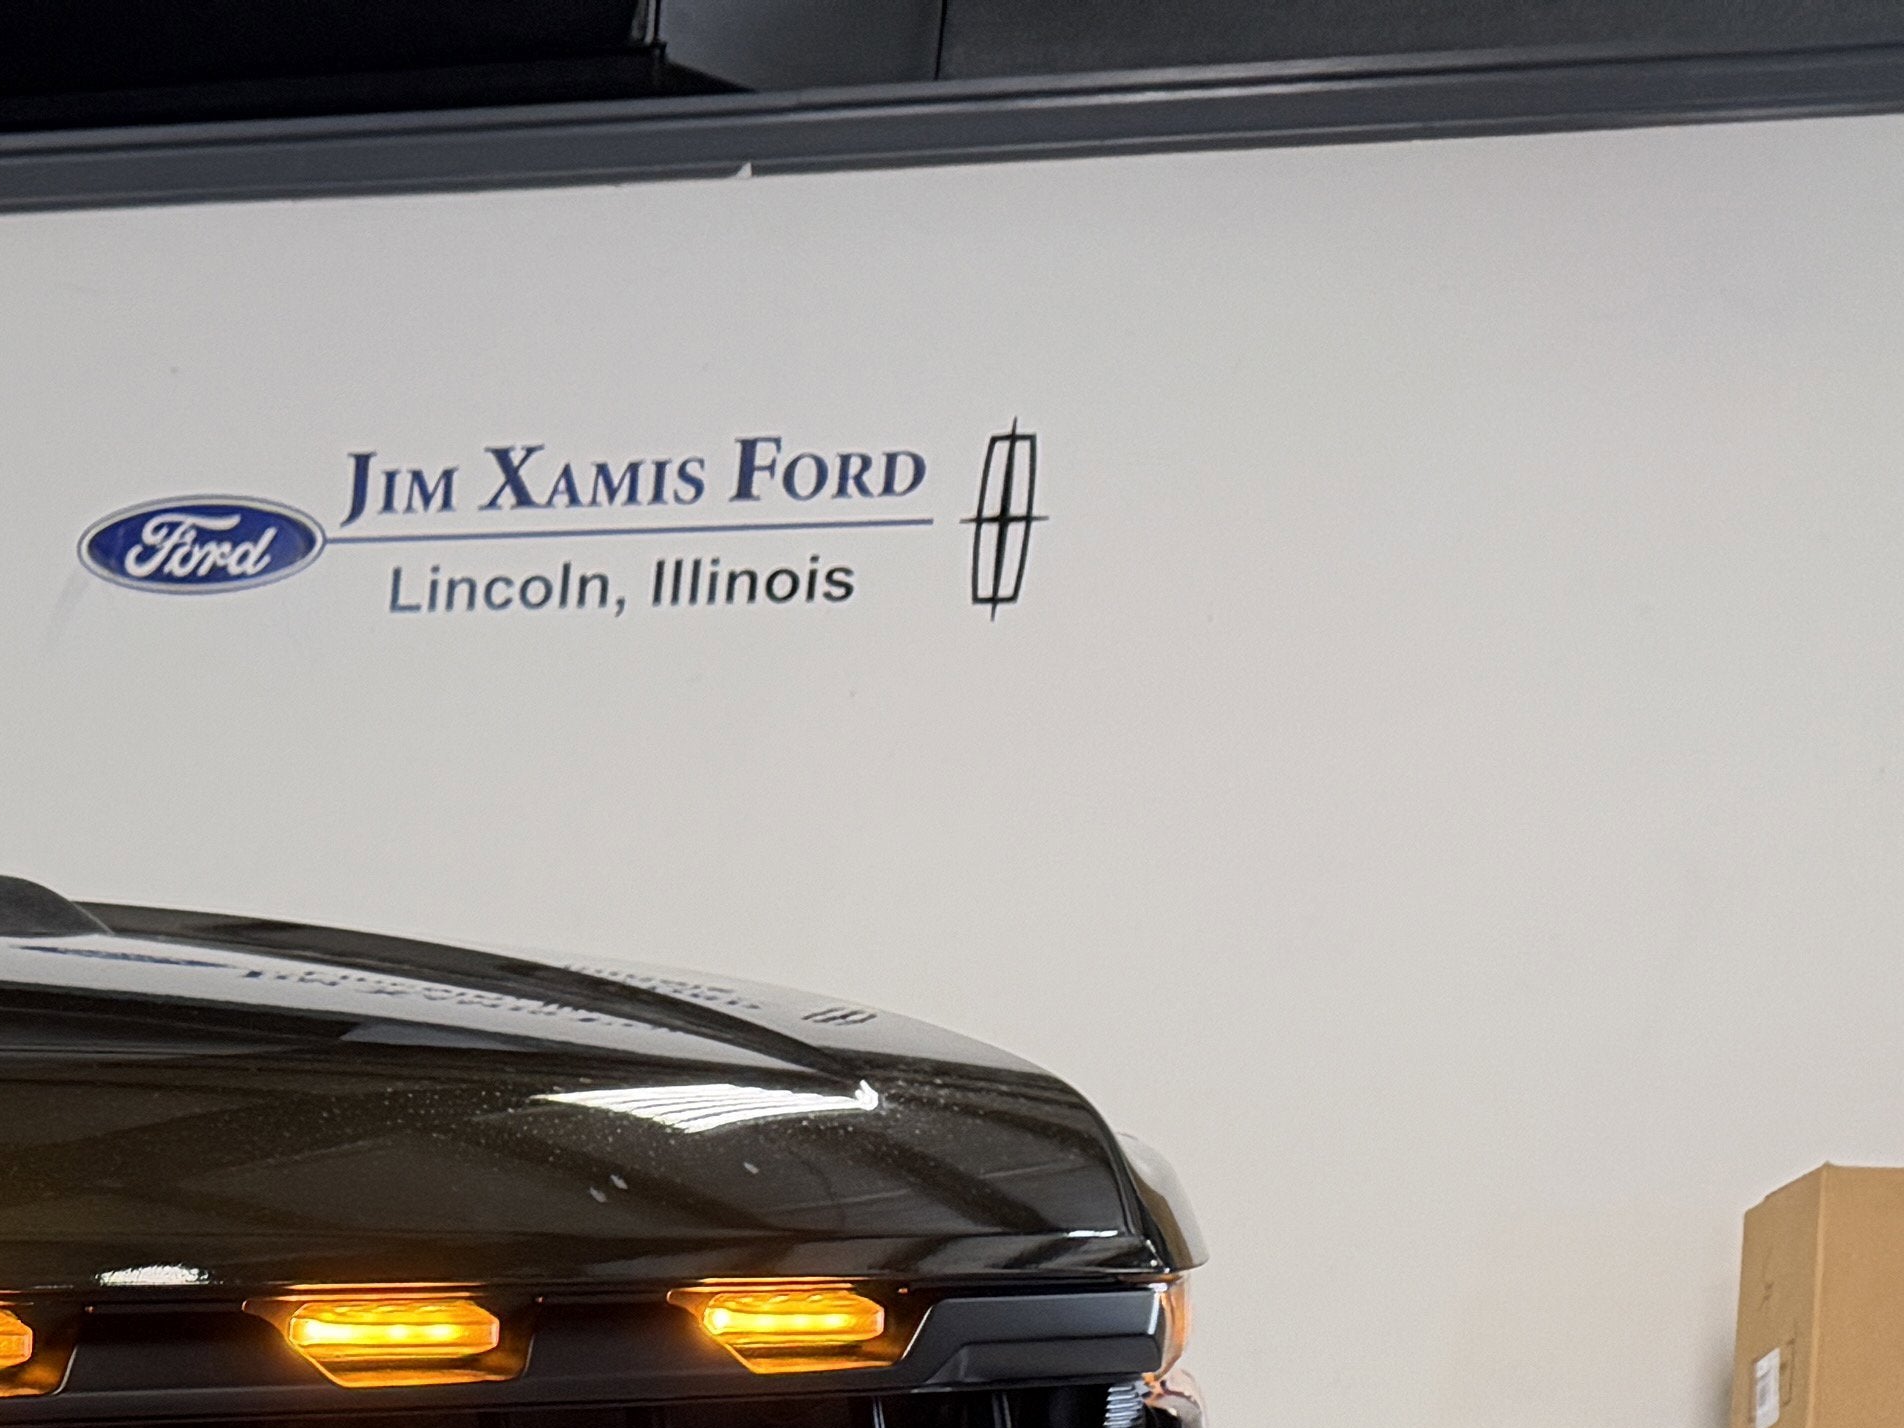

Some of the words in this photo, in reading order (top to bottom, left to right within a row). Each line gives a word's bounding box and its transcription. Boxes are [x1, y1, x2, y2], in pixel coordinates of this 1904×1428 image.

[340, 451, 457, 526] JIM
[478, 444, 704, 513] XAMIS
[729, 436, 927, 503] FORD
[124, 511, 271, 580] Ford
[388, 561, 628, 619] Lincoln,
[650, 557, 855, 608] Illinois
